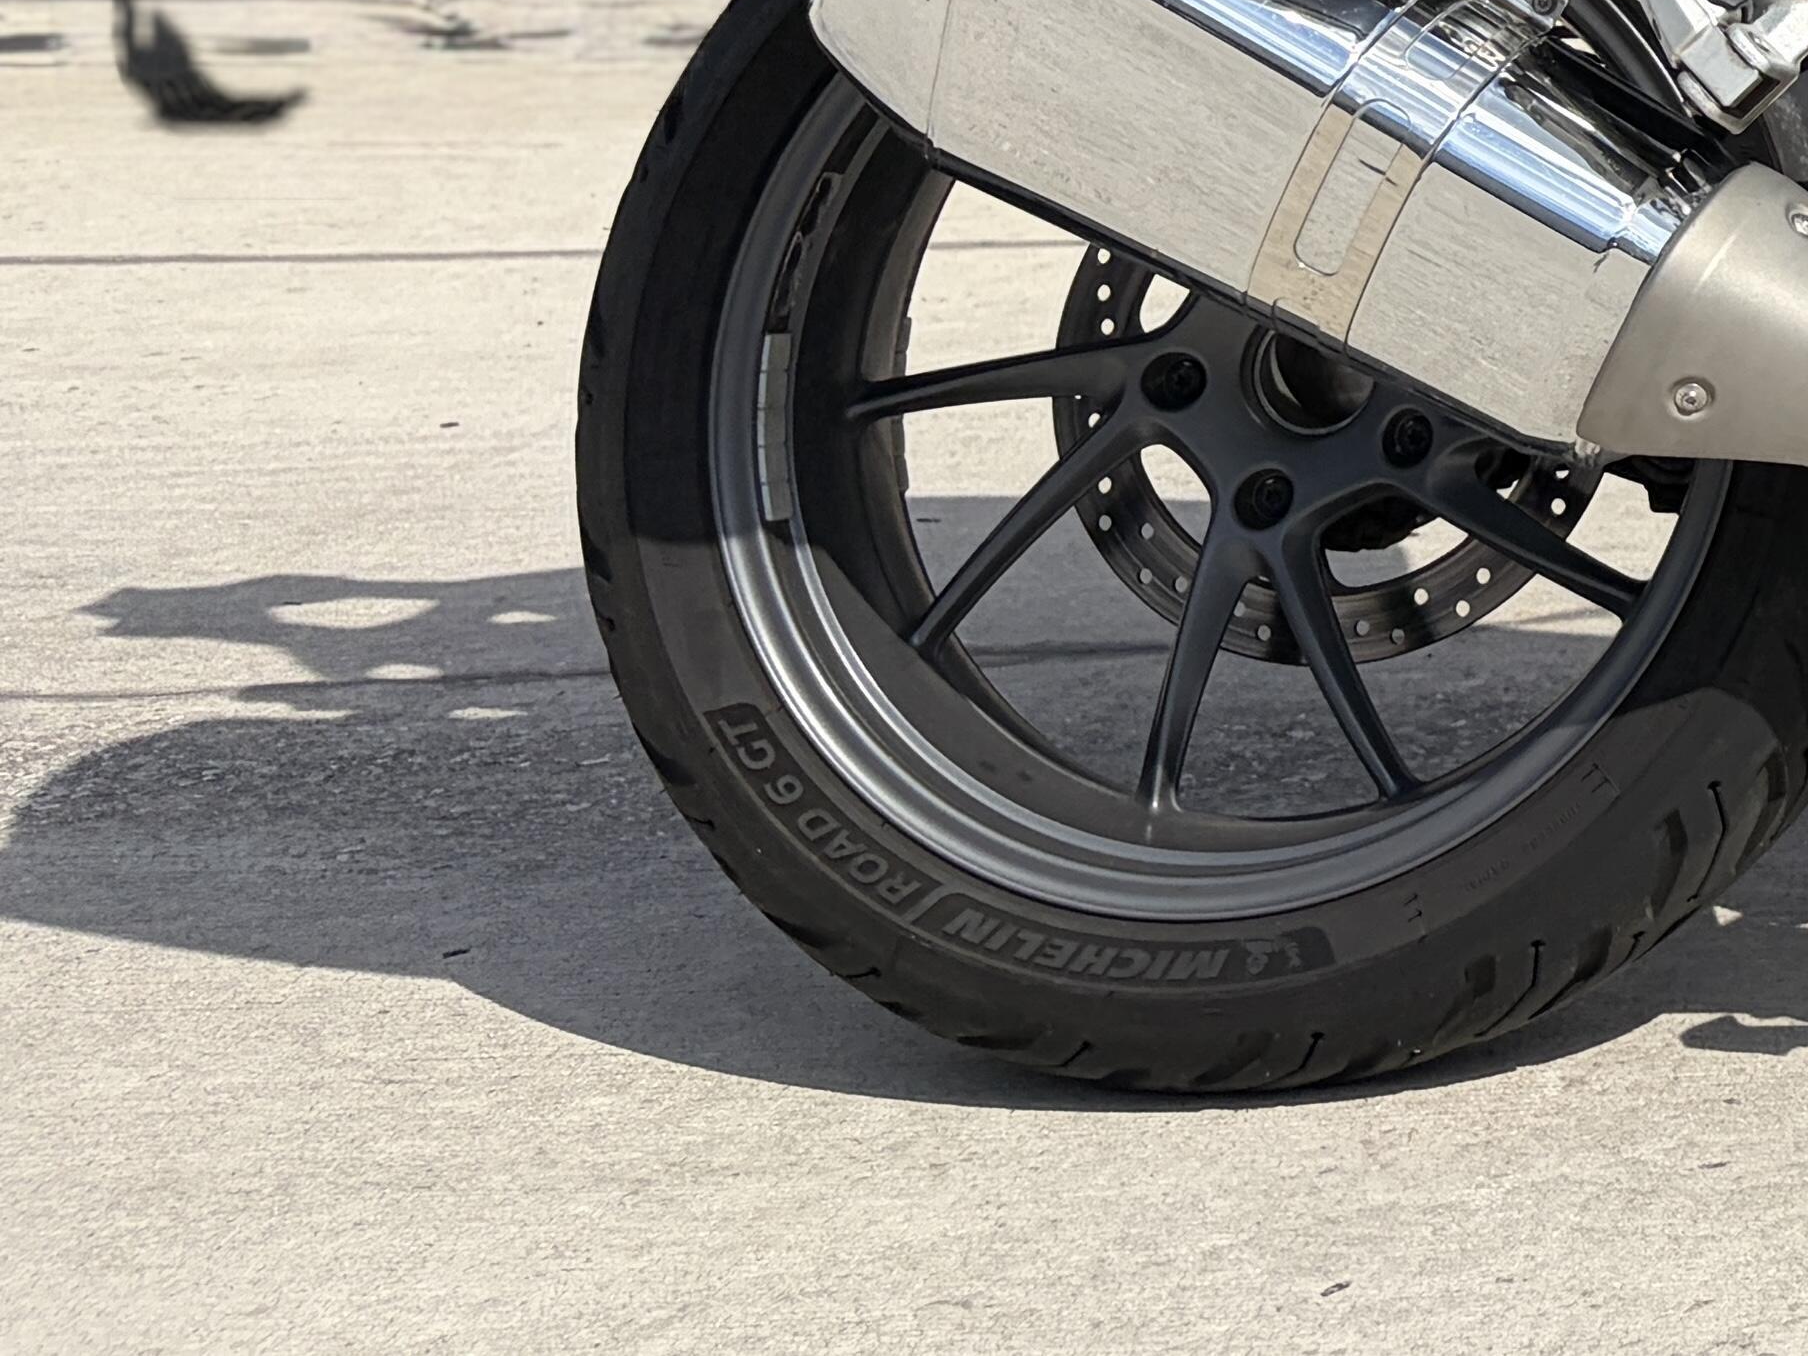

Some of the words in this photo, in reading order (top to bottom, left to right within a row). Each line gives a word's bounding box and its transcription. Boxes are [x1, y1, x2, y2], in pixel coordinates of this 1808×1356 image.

[718, 719, 776, 771] GT
[764, 774, 803, 805] 6
[797, 808, 921, 904] ROAD
[942, 908, 1229, 981] MICHELIN
